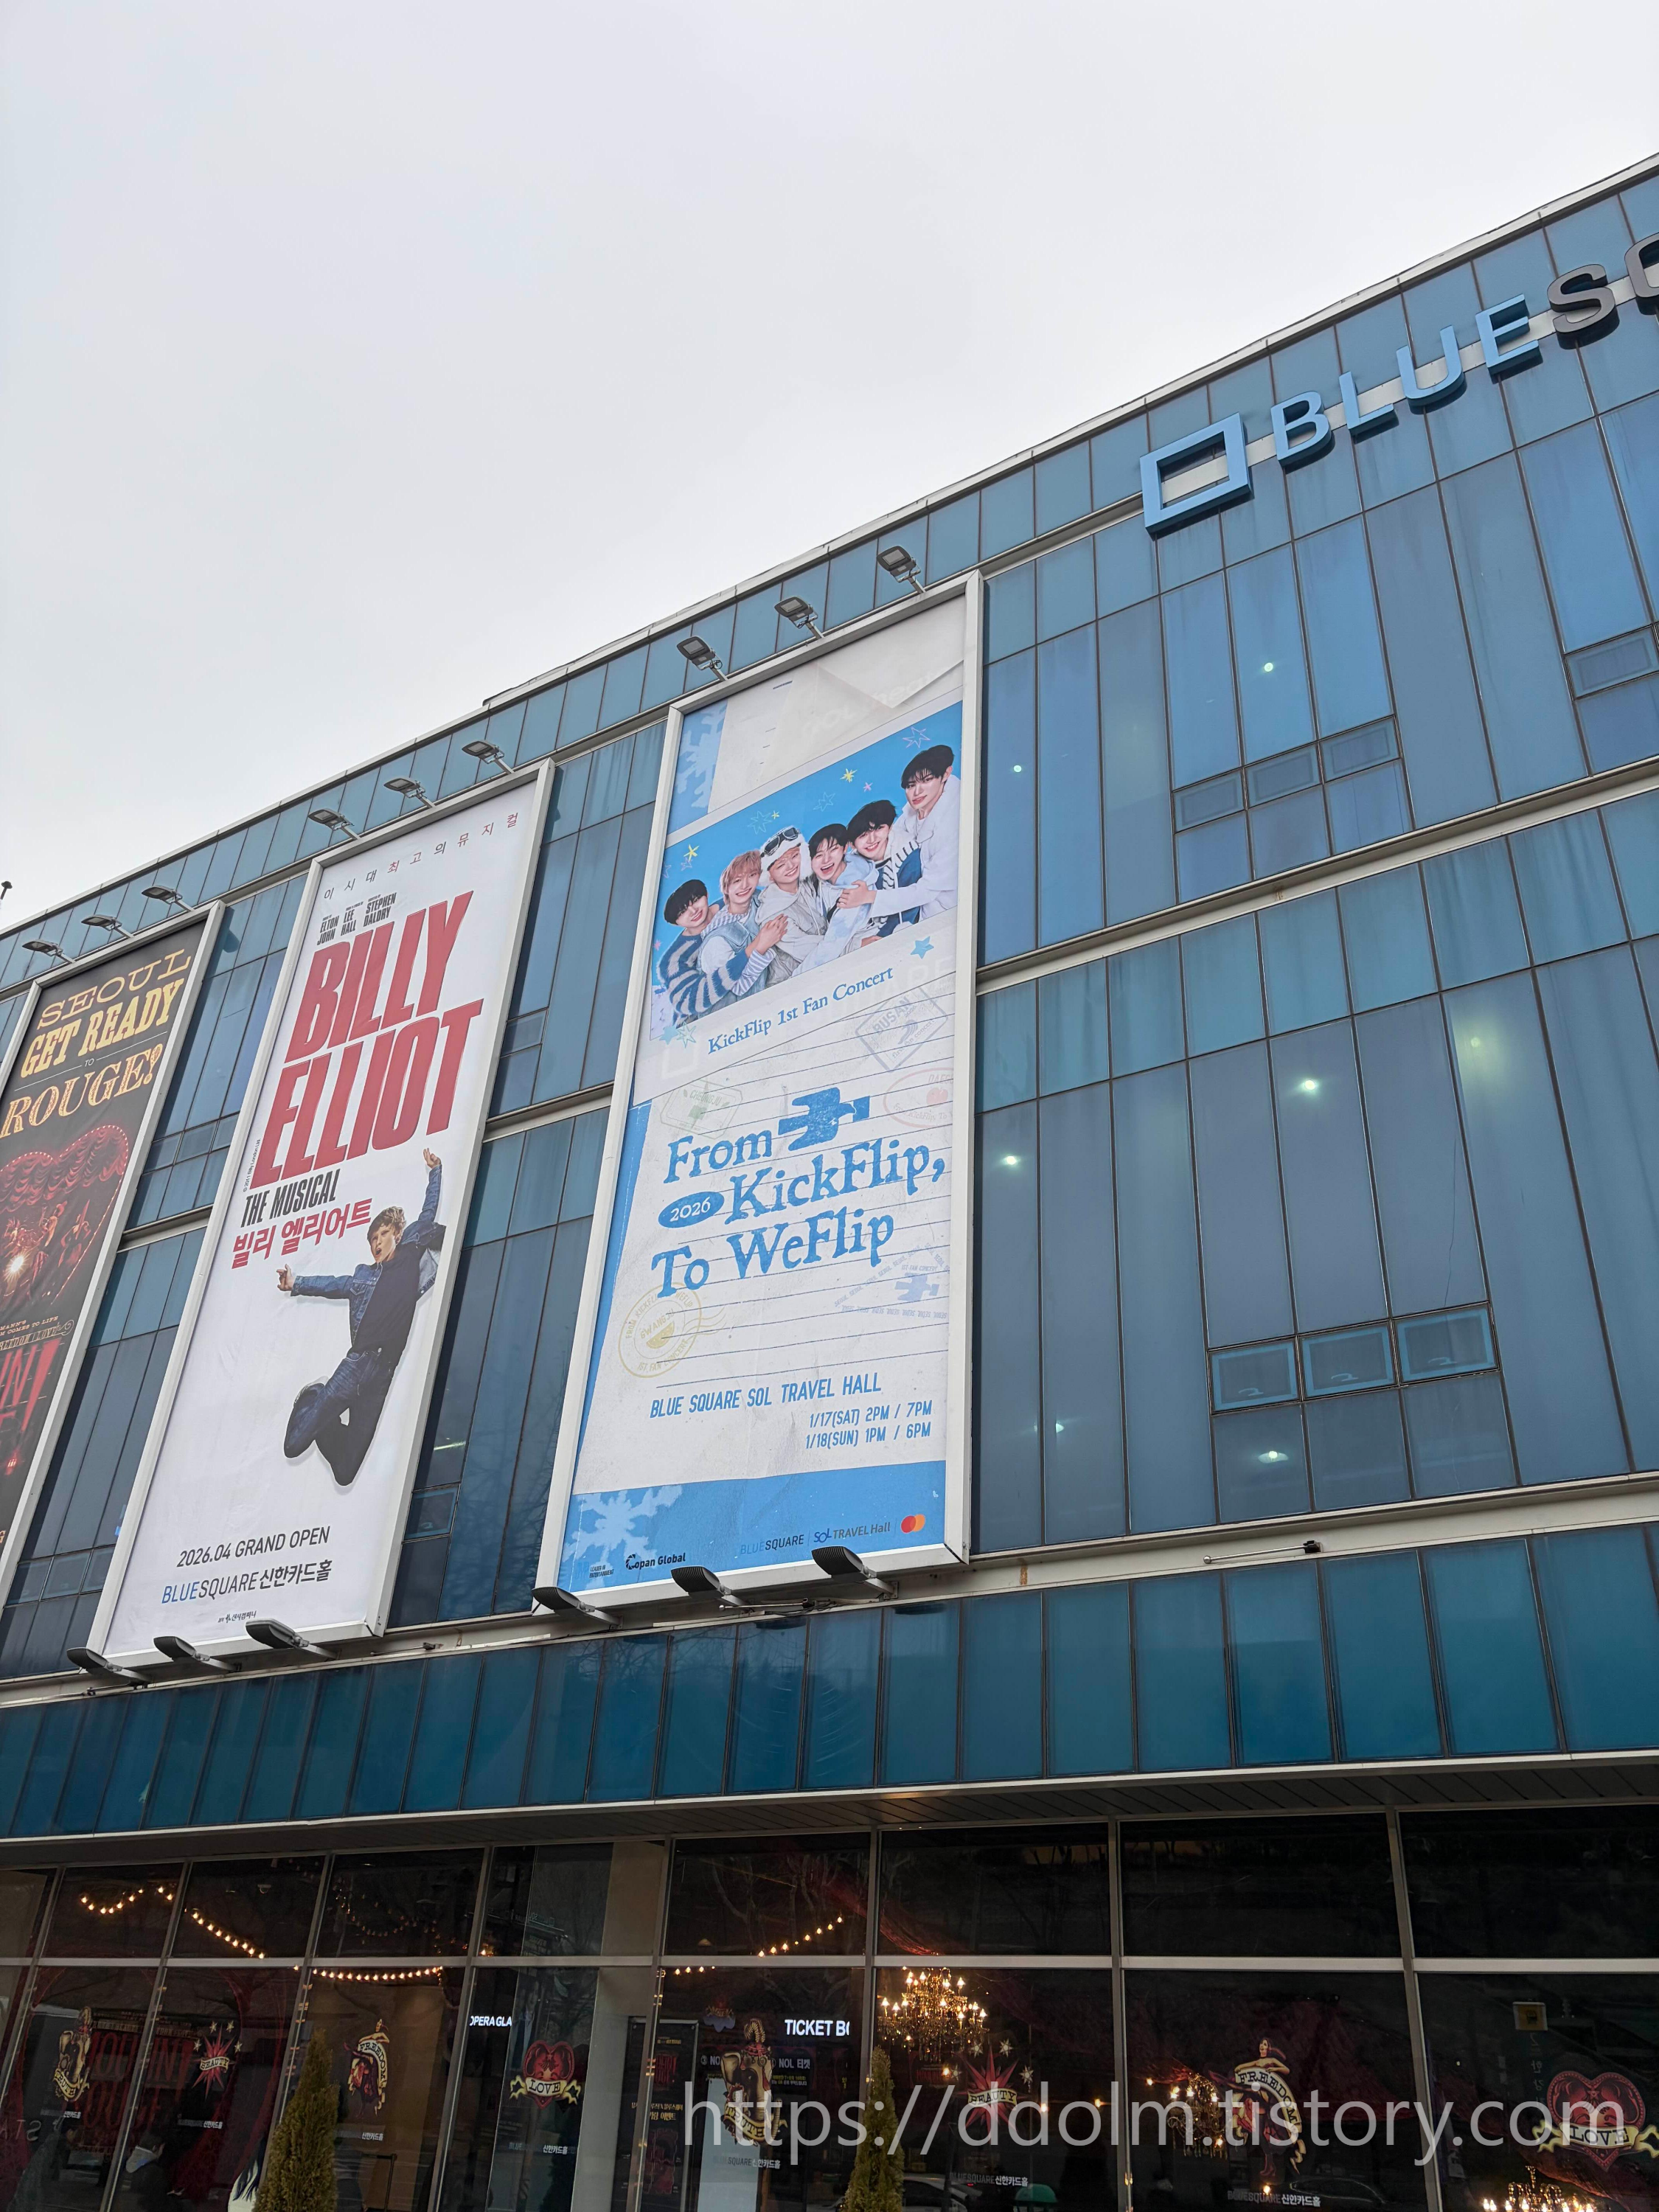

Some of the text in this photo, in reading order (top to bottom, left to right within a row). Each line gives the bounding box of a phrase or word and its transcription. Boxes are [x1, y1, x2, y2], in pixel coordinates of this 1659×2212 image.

[344, 909, 355, 923] LEE
[364, 906, 392, 927] DALDRY
[366, 892, 397, 914] STEPHEN
[317, 928, 336, 945] JOHN
[320, 915, 339, 933] ELTON
[341, 919, 356, 936] HALL
[37, 948, 192, 1030] SEOUL
[285, 890, 474, 1063] BILLY
[707, 1017, 771, 1055] KickFlip
[777, 1006, 799, 1026] 1st
[802, 996, 828, 1016] Fan
[833, 967, 894, 1001] Concert
[872, 996, 911, 1035] BUSAN
[21, 978, 184, 1078] GET READY
[84, 1057, 94, 1067] TO
[0, 1043, 163, 1138] ROUGE!
[249, 998, 484, 1189] ELLIOT
[663, 1127, 772, 1184] From
[241, 1169, 339, 1228] THE MUSICAL
[669, 1140, 945, 1225] 2026 KickFlip,
[232, 1198, 373, 1269] 빌리 엘리어트
[651, 1206, 894, 1299] To WeFlip
[650, 1373, 881, 1419] BLUE SQUARE SOL TRAVEL HALL
[810, 1400, 932, 1428] 1/17(SAT) 2PM / 7PM
[805, 1422, 931, 1449] 1/18(SUN) 1PM / 6PM
[176, 1526, 330, 1568] 2026.04 GRAND OPEN
[740, 1534, 804, 1554] BLUESQUARE
[832, 1526, 869, 1539] TRAVEL
[870, 1522, 891, 1534] Hall
[259, 1559, 332, 1590] 신한카드홀
[658, 1553, 686, 1565] Global
[785, 2019, 850, 2037] TICKET B
[359, 2042, 388, 2081] FREEDOM
[779, 2058, 810, 2070] NOL 티켓
[529, 2079, 561, 2094] LOVE
[969, 2090, 1016, 2104] BEAUTY
[1237, 2071, 1298, 2122] FREEDOM
[1570, 2127, 1630, 2144] LOVE
